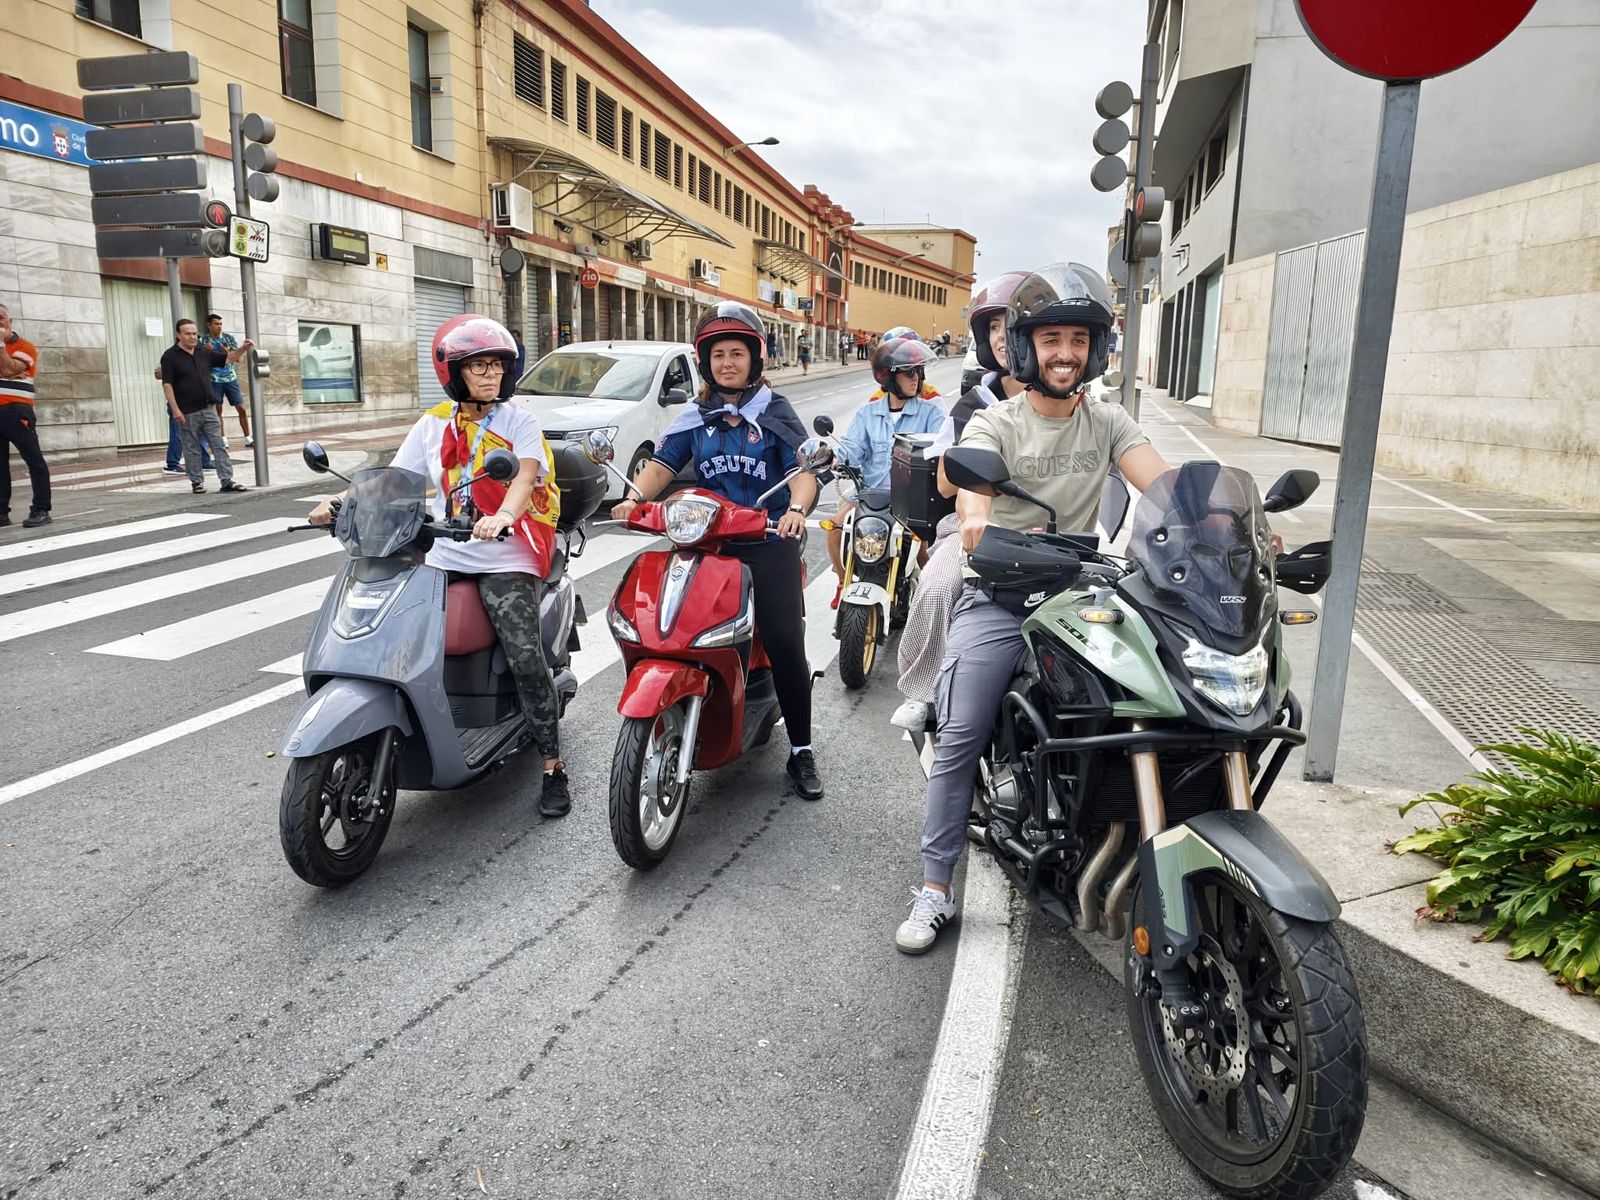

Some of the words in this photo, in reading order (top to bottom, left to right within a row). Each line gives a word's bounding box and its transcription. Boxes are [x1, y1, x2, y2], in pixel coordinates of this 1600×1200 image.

[582, 270, 597, 281] ria
[700, 455, 767, 480] CEUTA
[1014, 450, 1099, 478] GUESS
[1028, 591, 1046, 601] NIKE
